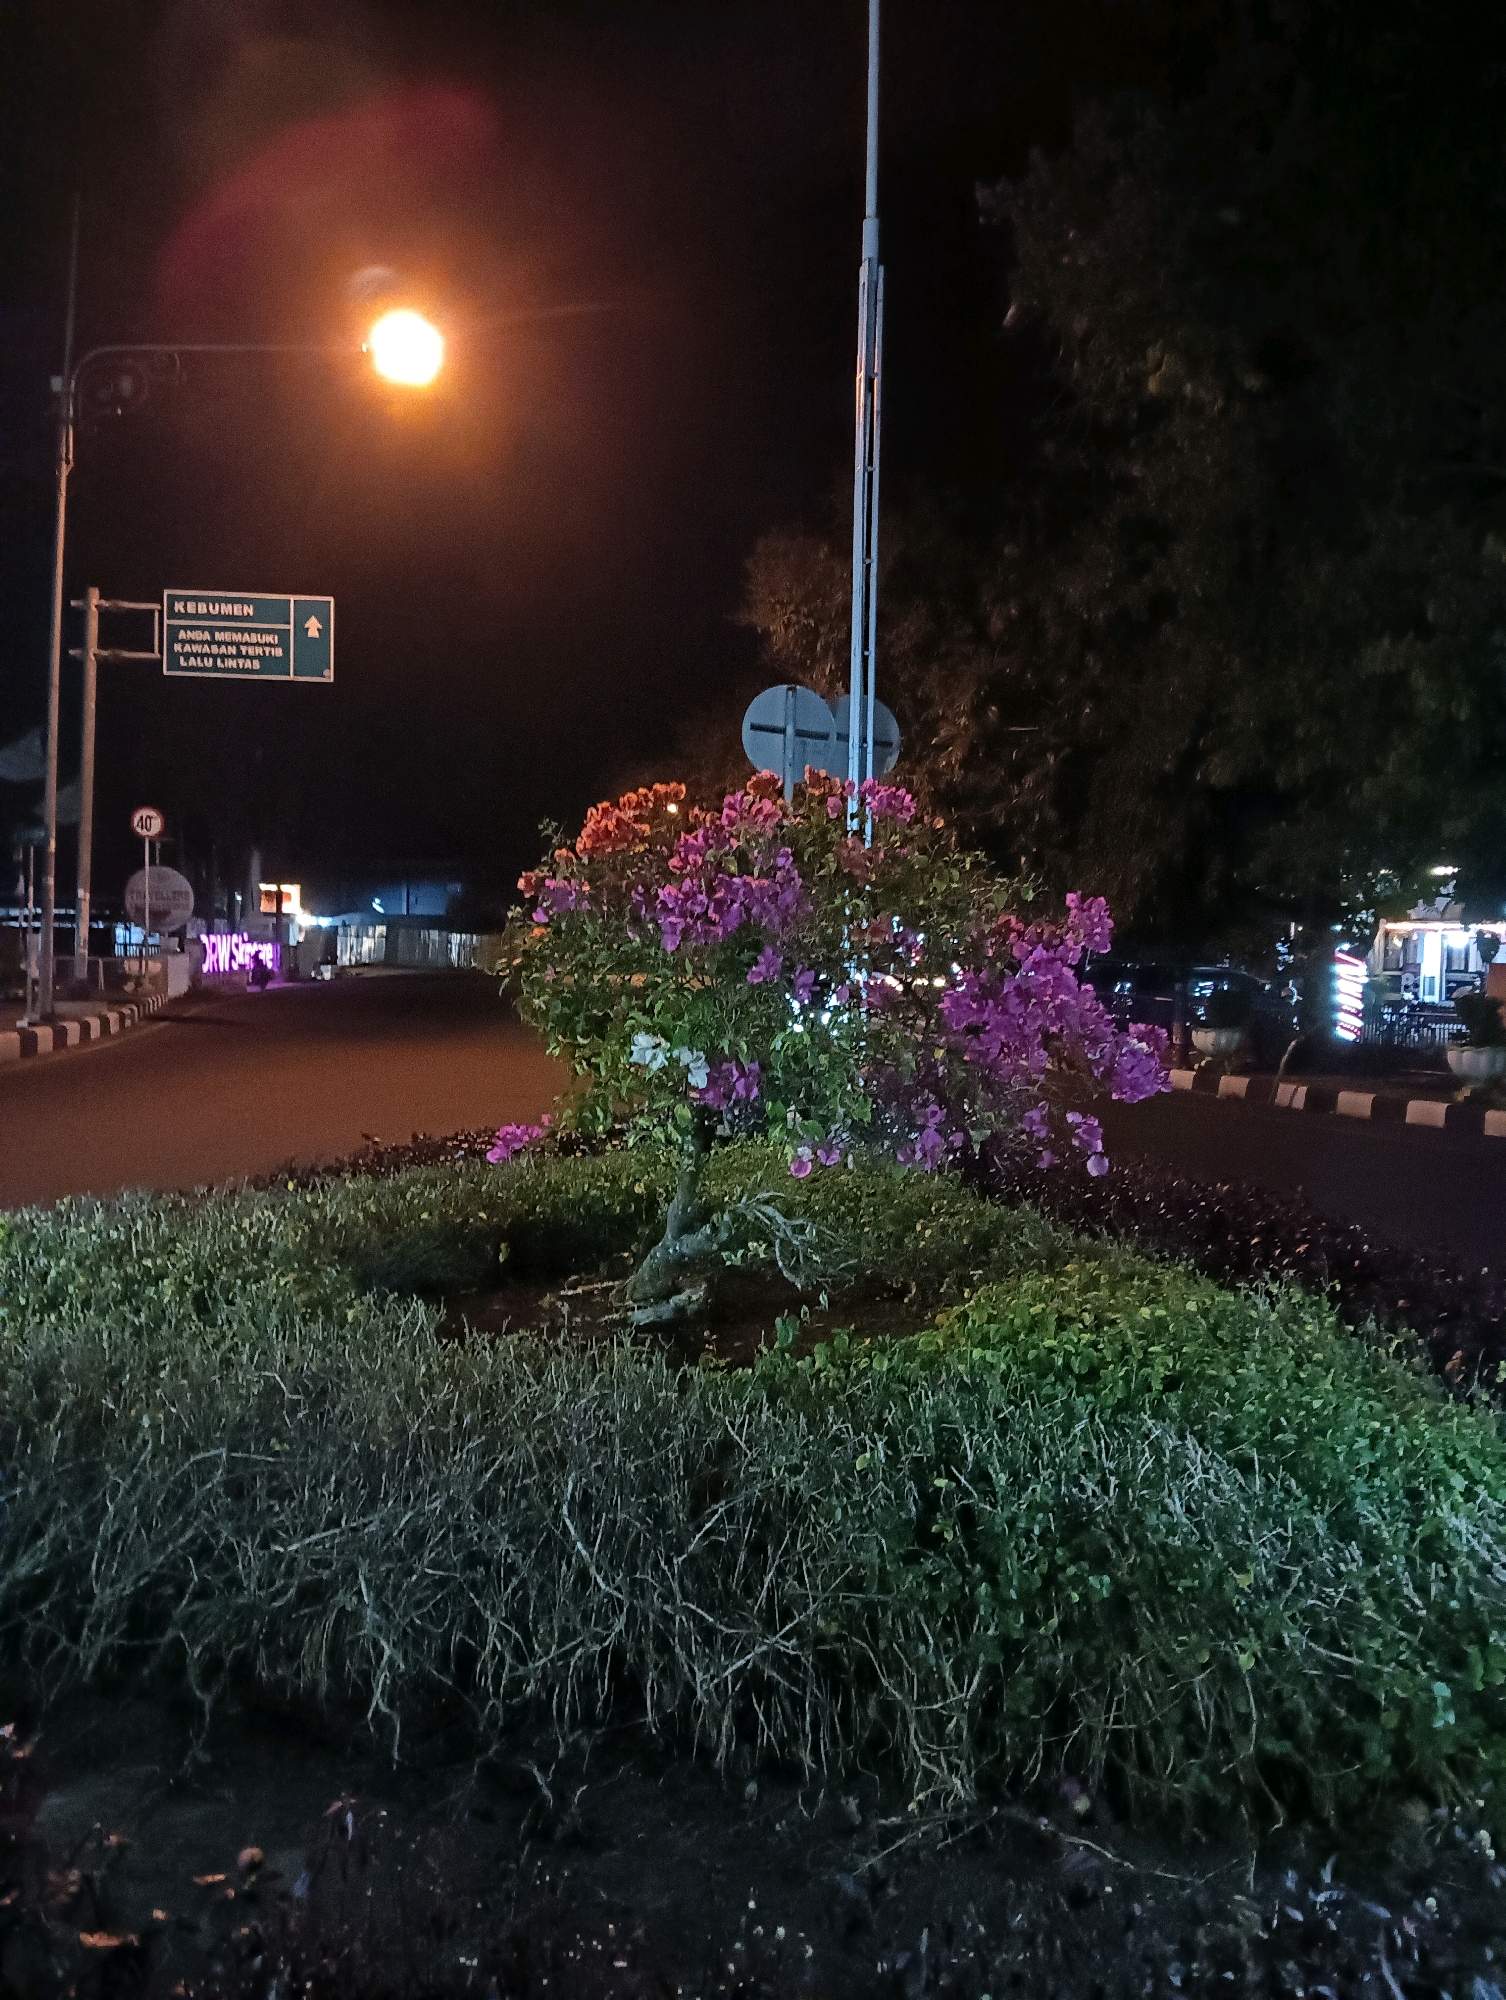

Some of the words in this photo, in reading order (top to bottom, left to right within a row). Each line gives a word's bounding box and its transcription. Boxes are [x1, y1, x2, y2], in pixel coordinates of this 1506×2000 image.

[174, 601, 254, 616] KEBUMEN
[178, 629, 211, 640] ANDA
[240, 645, 283, 657] TERTIB
[179, 656, 213, 667] LALU
[216, 658, 260, 669] LINTAS
[137, 814, 153, 832] 40
